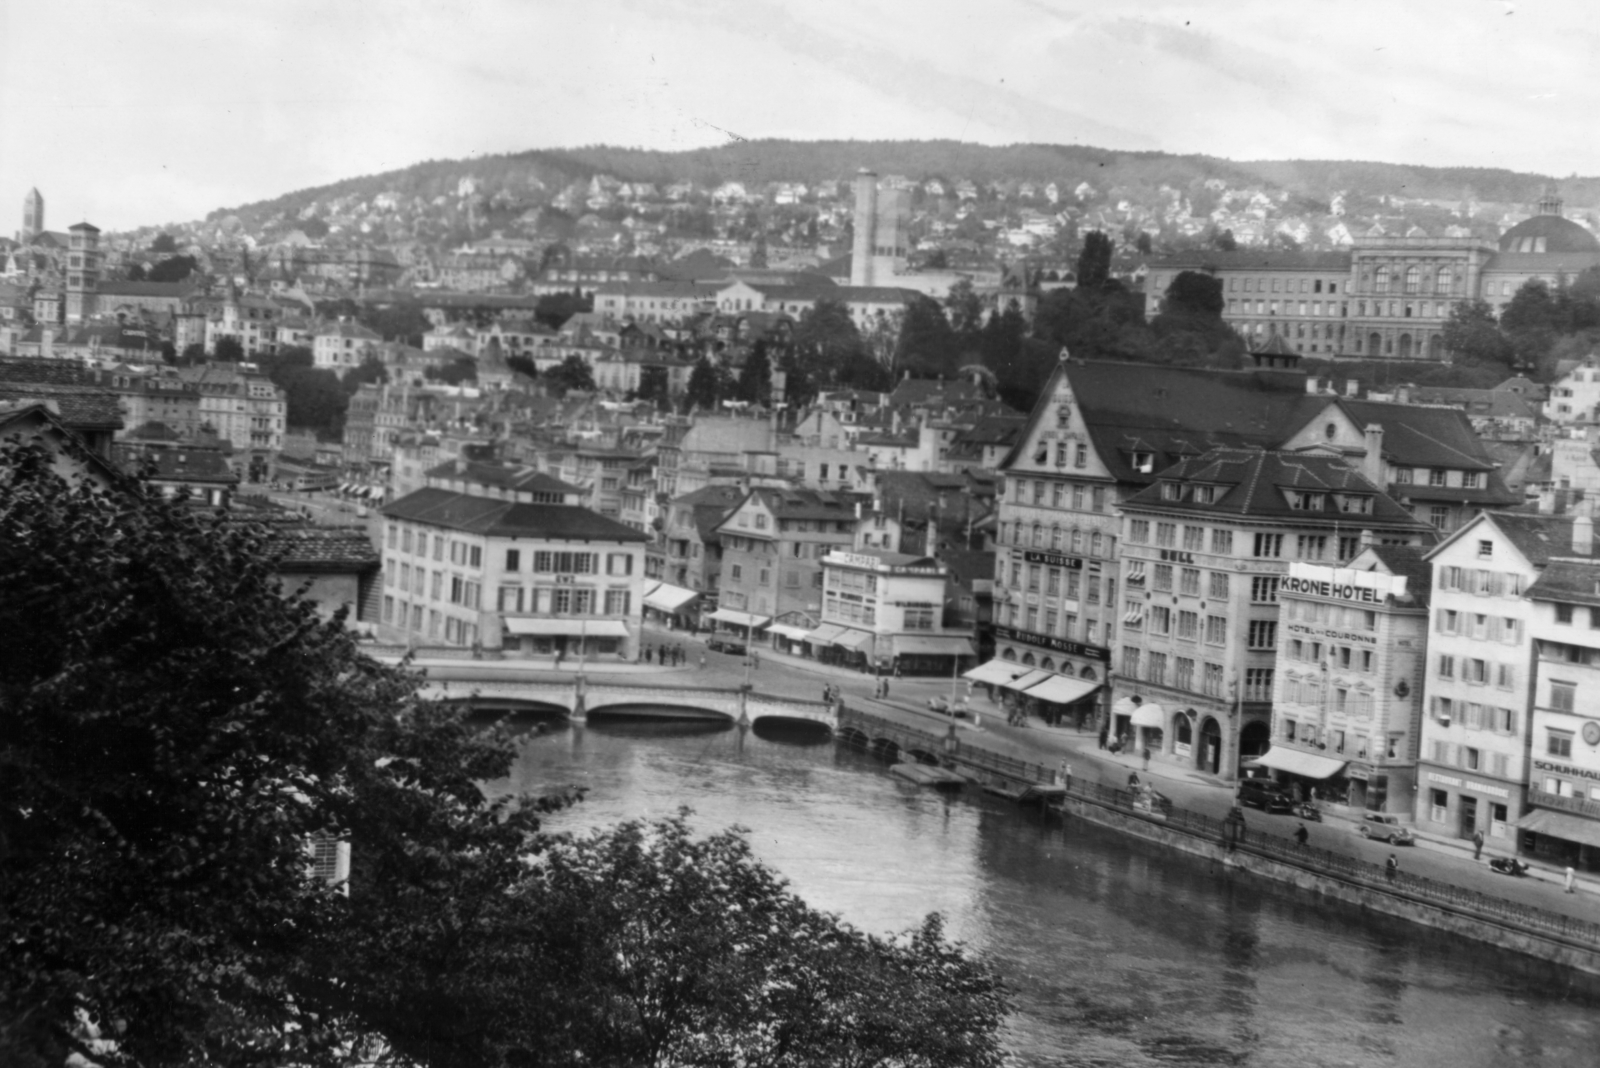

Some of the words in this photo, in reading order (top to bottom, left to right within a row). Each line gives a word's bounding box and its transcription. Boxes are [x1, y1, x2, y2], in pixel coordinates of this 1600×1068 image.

[1030, 554, 1041, 562] LA
[1044, 556, 1076, 567] SUISSE
[1281, 577, 1330, 596] KRONE
[1332, 584, 1383, 603] HOTEL
[1016, 631, 1046, 645] RUDOLF
[1051, 639, 1078, 653] MOSSE
[1288, 625, 1315, 635] HOTEL
[1325, 630, 1377, 644] COURONNE
